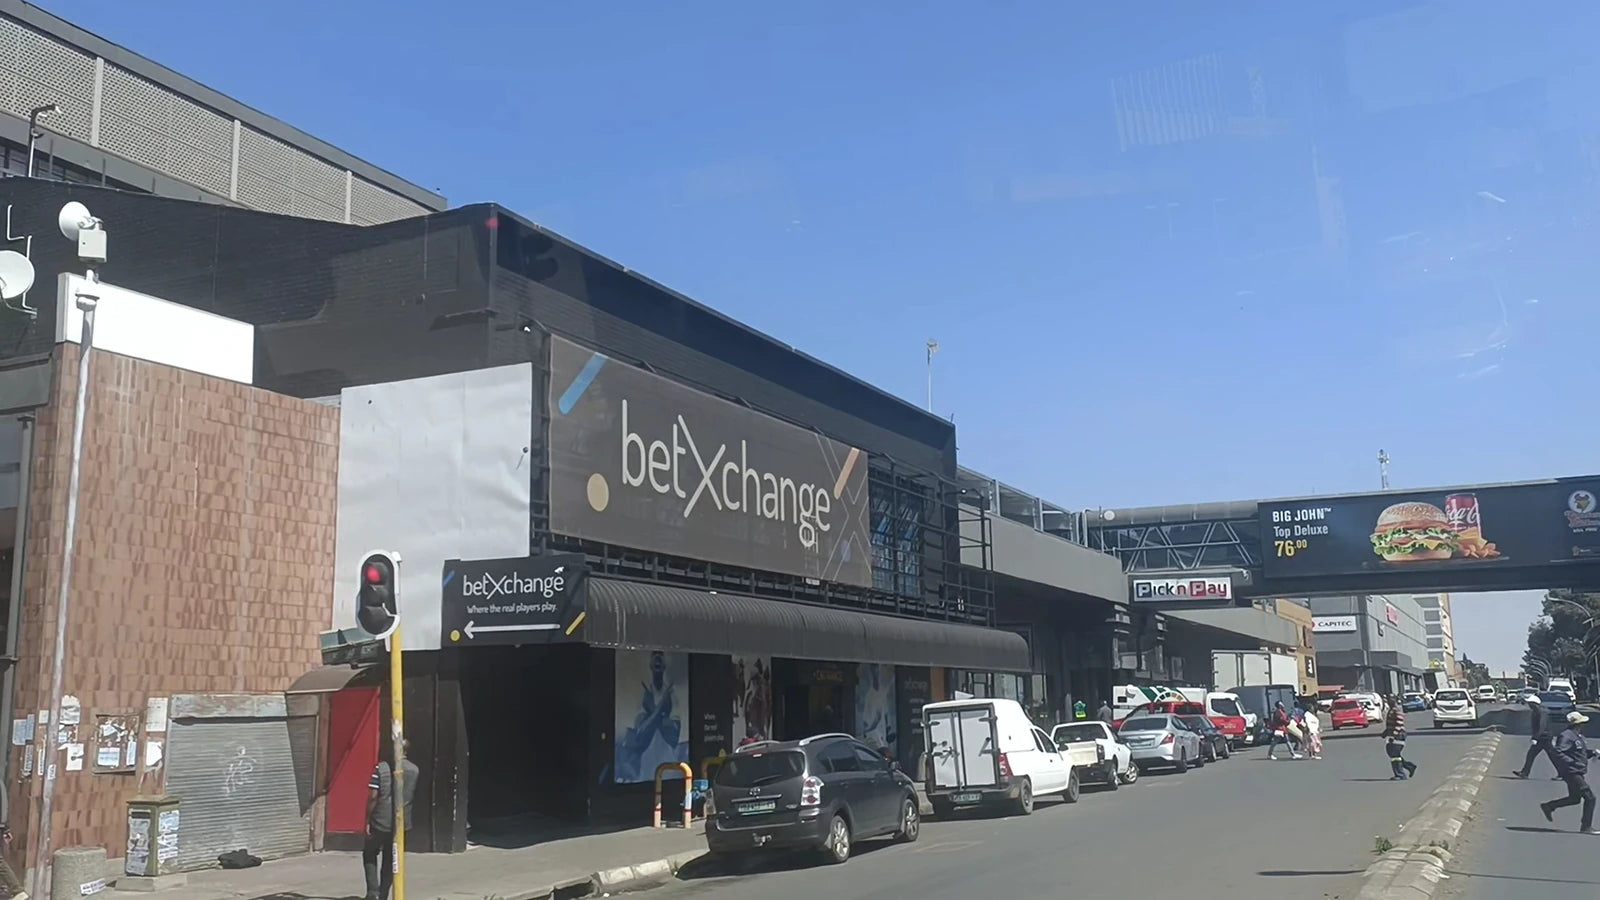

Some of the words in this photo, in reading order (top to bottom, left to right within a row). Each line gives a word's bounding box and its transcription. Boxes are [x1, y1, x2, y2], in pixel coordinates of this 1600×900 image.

[621, 398, 831, 548] betXchange
[1272, 510, 1292, 522] BIG
[1273, 525, 1291, 539] Top
[1294, 524, 1329, 536] Deluxe
[463, 571, 564, 600] betXchange
[1136, 582, 1174, 598] Pick
[1177, 584, 1186, 595] n
[1190, 581, 1227, 598] Pay
[489, 604, 501, 613] the
[502, 603, 515, 613] real
[516, 602, 541, 614] players
